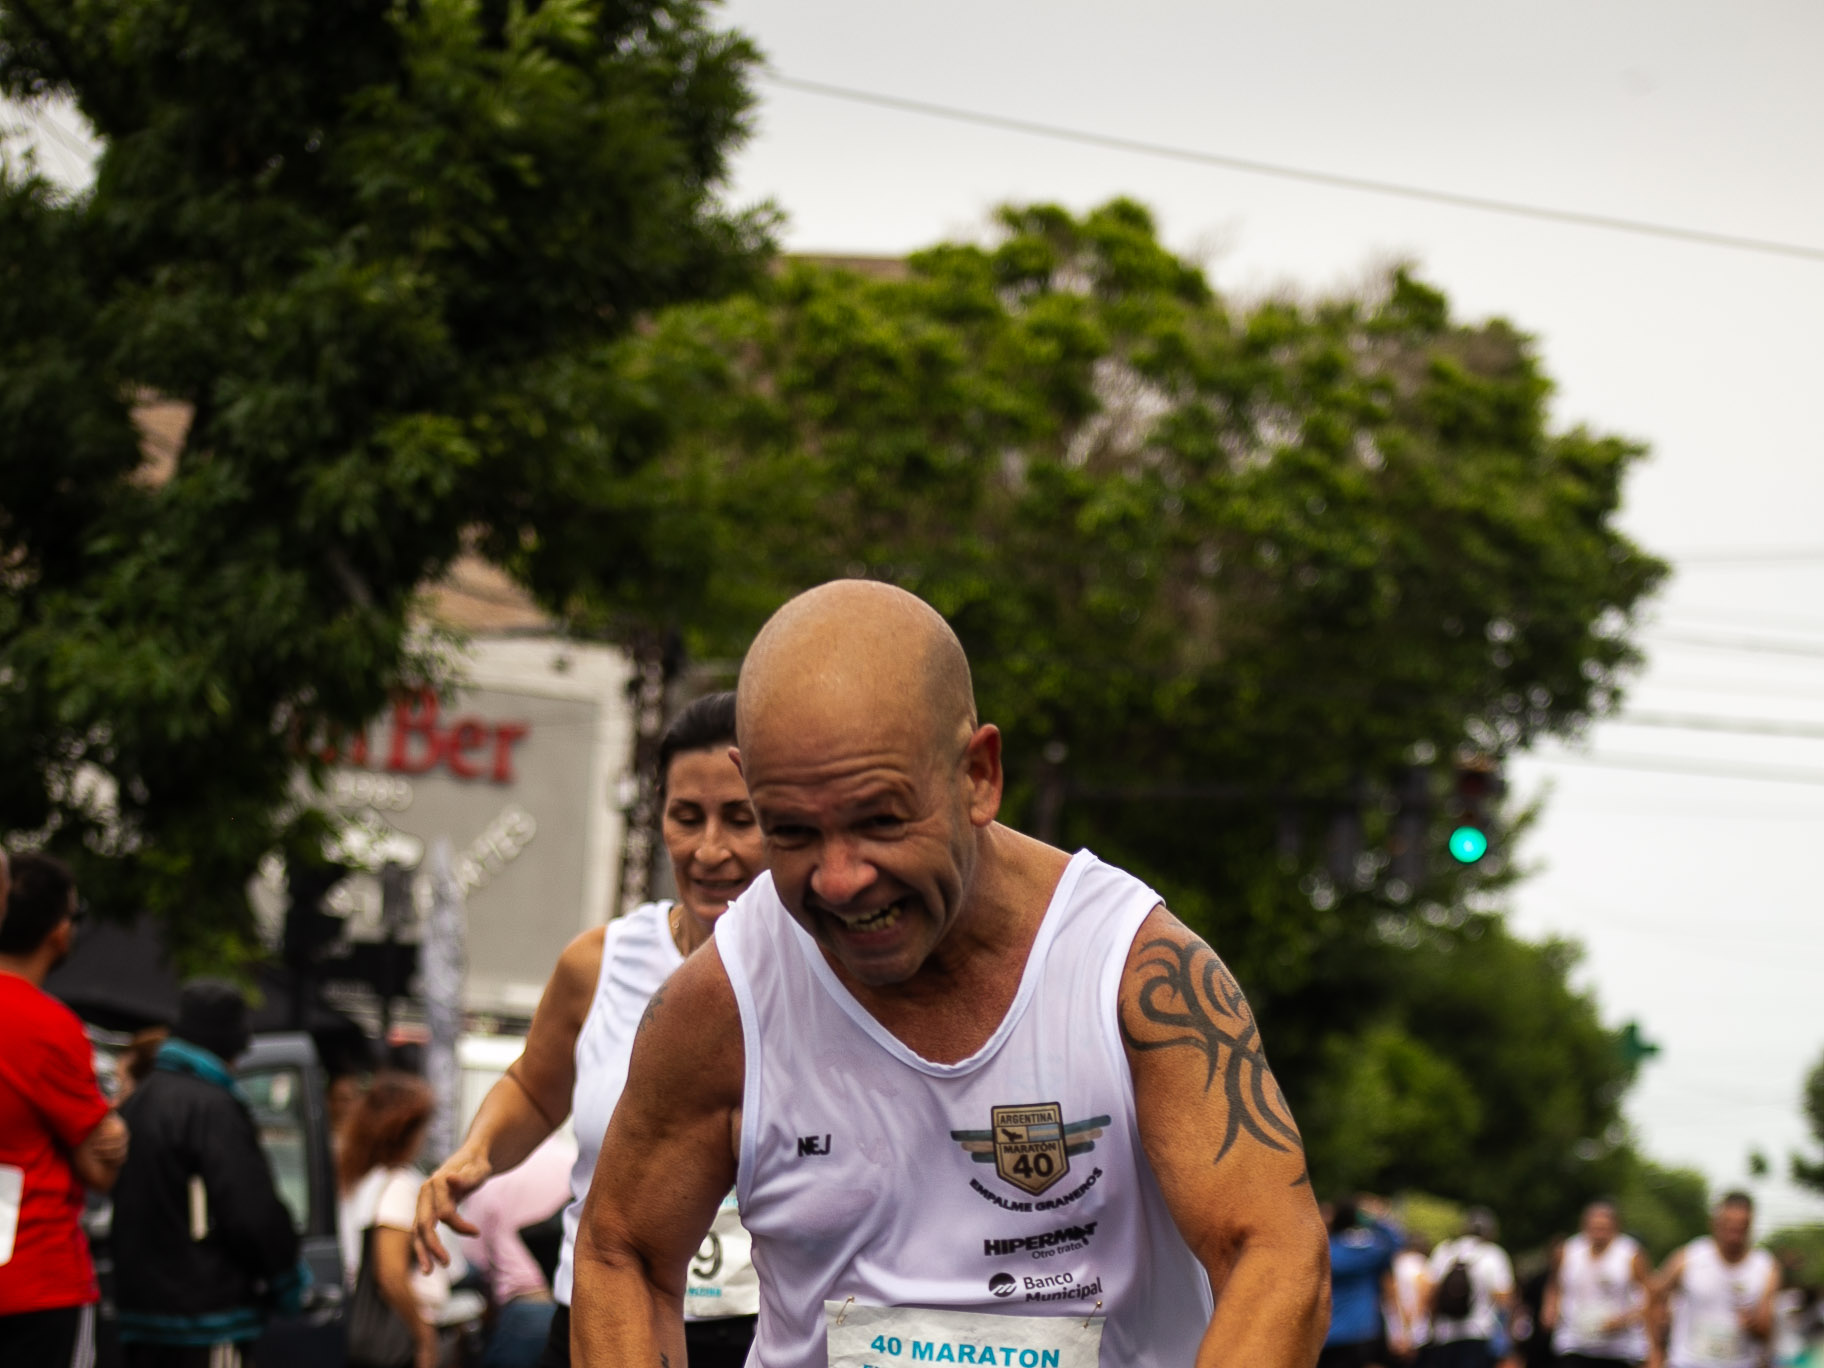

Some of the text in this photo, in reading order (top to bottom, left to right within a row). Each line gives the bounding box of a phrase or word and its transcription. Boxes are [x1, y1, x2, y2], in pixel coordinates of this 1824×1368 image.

[1000, 1112, 1053, 1125] ARGENTINA
[797, 1134, 832, 1158] NEJ
[1012, 1153, 1054, 1179] 40
[968, 1166, 1103, 1213] EMPALME GRANEROS
[1031, 1249, 1056, 1260] Otro
[1023, 1272, 1074, 1290] Banco
[1025, 1276, 1103, 1302] Municipal
[870, 1335, 1061, 1368] 40 MARATON
